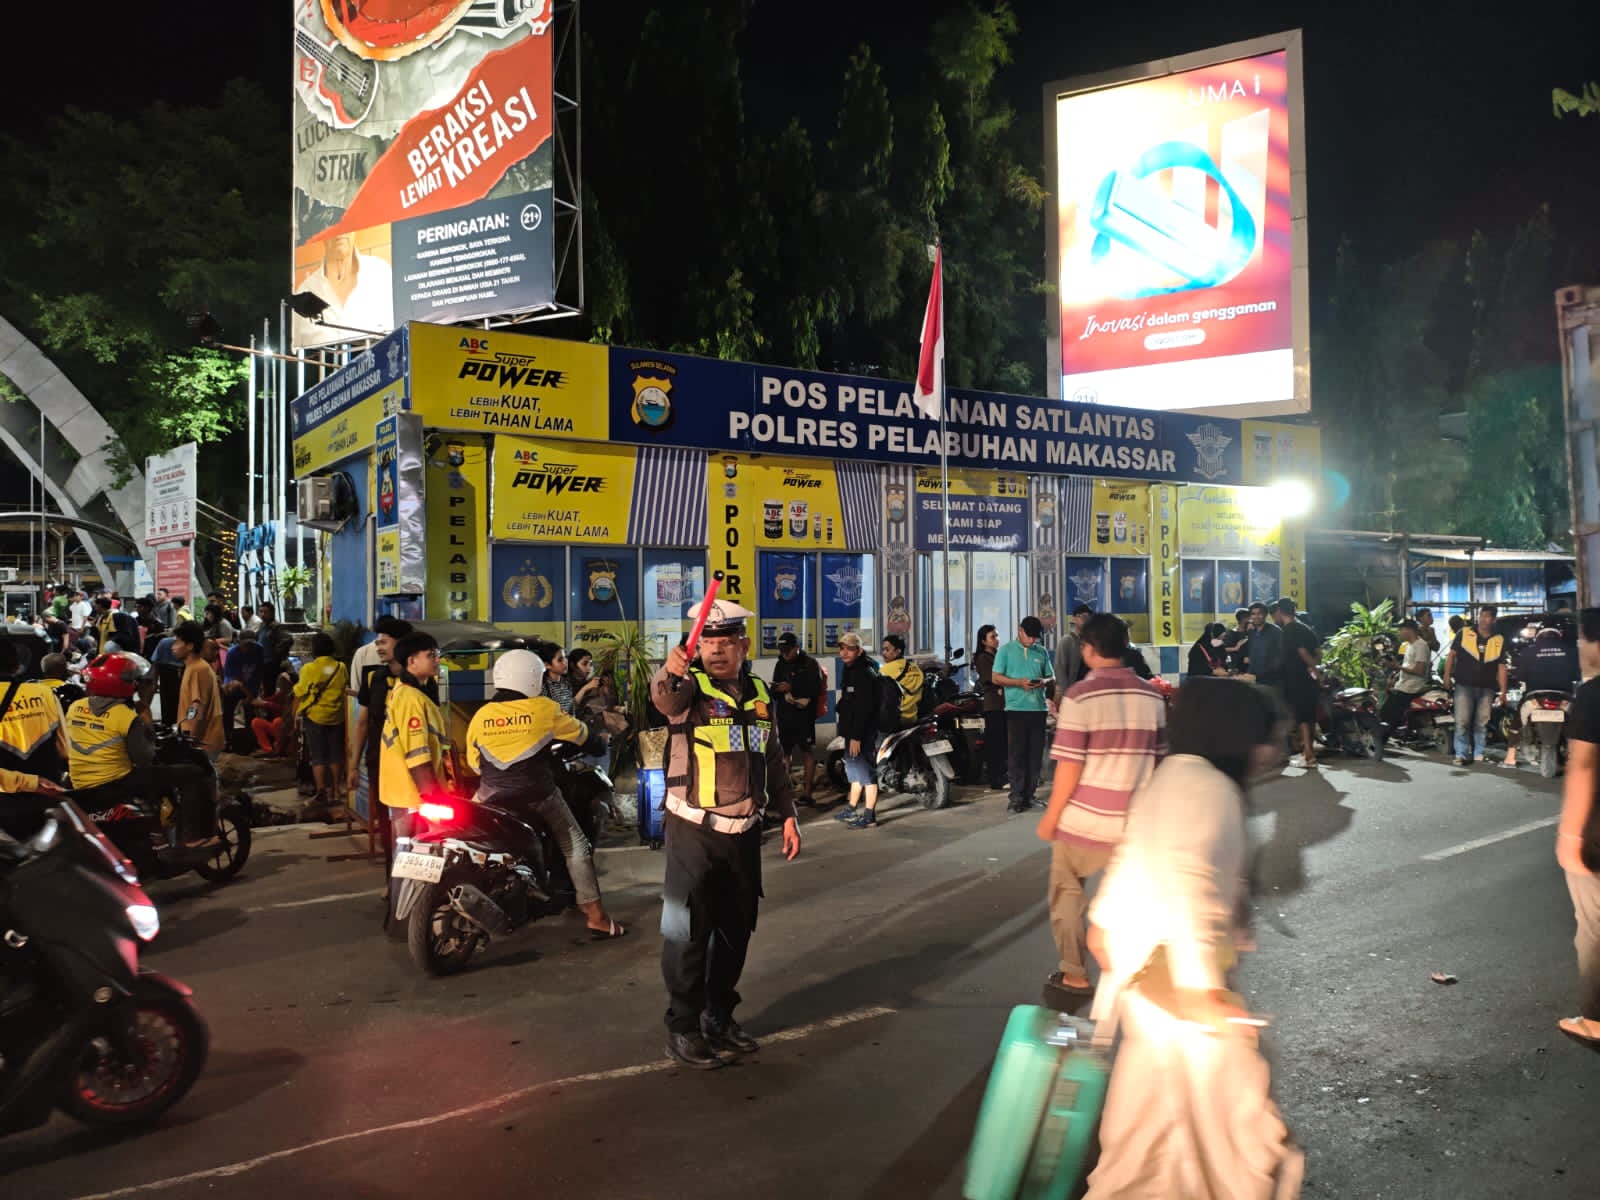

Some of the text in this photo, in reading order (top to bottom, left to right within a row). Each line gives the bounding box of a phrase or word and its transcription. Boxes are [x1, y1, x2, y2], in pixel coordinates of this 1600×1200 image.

[408, 79, 493, 179] BERAKSI
[400, 86, 538, 208] LEWAT KREASI
[417, 211, 539, 245] PERINGATAN: 21+
[1080, 312, 1147, 340] Inovasi
[1147, 312, 1190, 327] dalam
[1192, 301, 1277, 324] genggaman
[459, 337, 489, 350] ABC
[458, 361, 566, 389] POWER
[470, 394, 541, 413] LEBIH KUAT,
[762, 376, 1155, 441] POS PELANAN SATLANTAS
[450, 408, 574, 432] LEBIH TAHAN LAMA
[729, 410, 1177, 473] POLRES PELABUHAN MAKASSAR
[514, 449, 538, 461] ABC
[512, 471, 604, 496] POWER
[783, 478, 822, 489] POWER
[547, 510, 581, 523] KUAT,
[978, 502, 1022, 513] DATANG
[532, 524, 573, 536] TAHAN
[575, 525, 609, 537] LAMA
[976, 519, 1002, 528] SIAP
[725, 504, 741, 604] POLR
[1160, 525, 1172, 638] POLRES
